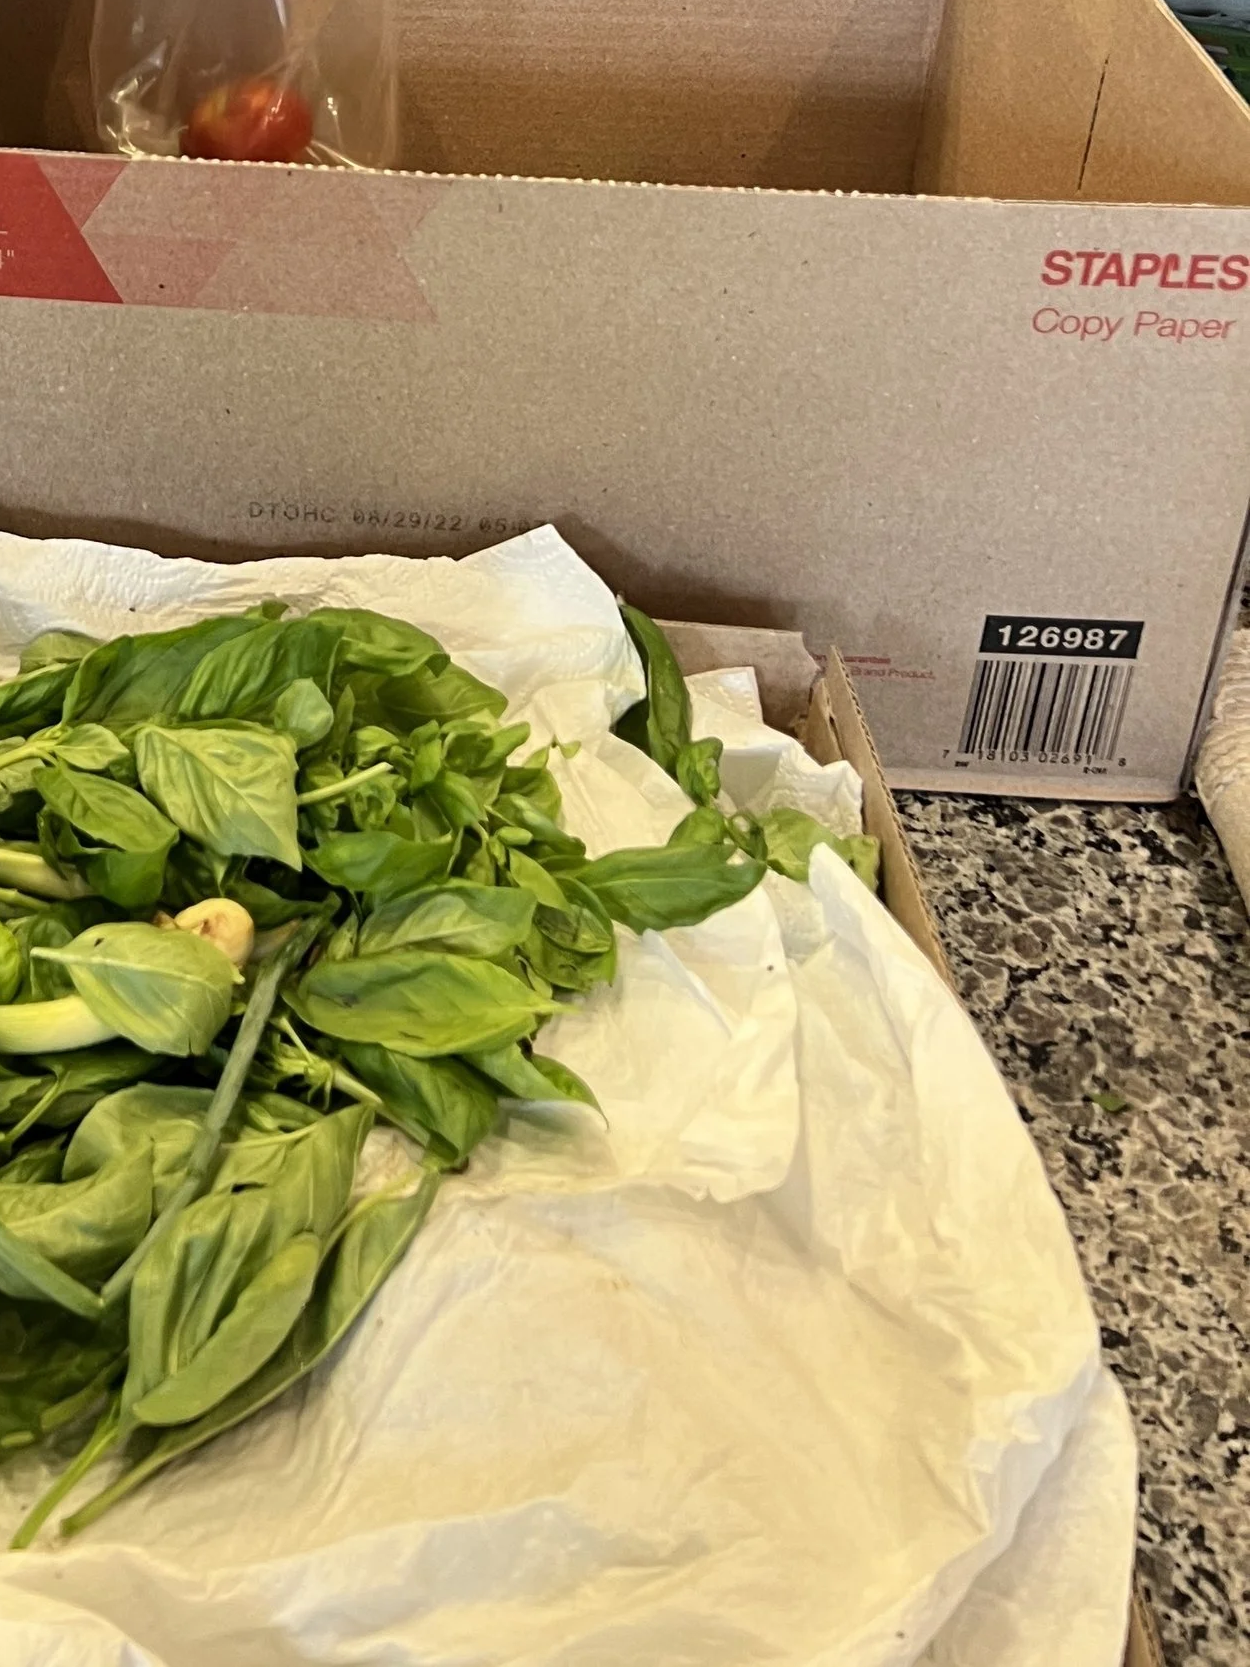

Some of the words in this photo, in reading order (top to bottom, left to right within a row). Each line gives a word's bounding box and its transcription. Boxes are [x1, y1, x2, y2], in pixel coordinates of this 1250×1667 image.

[1041, 249, 1250, 291] STAPLES
[1032, 307, 1125, 342] Copy
[1133, 310, 1237, 344] Paper
[998, 624, 1128, 651] 126987
